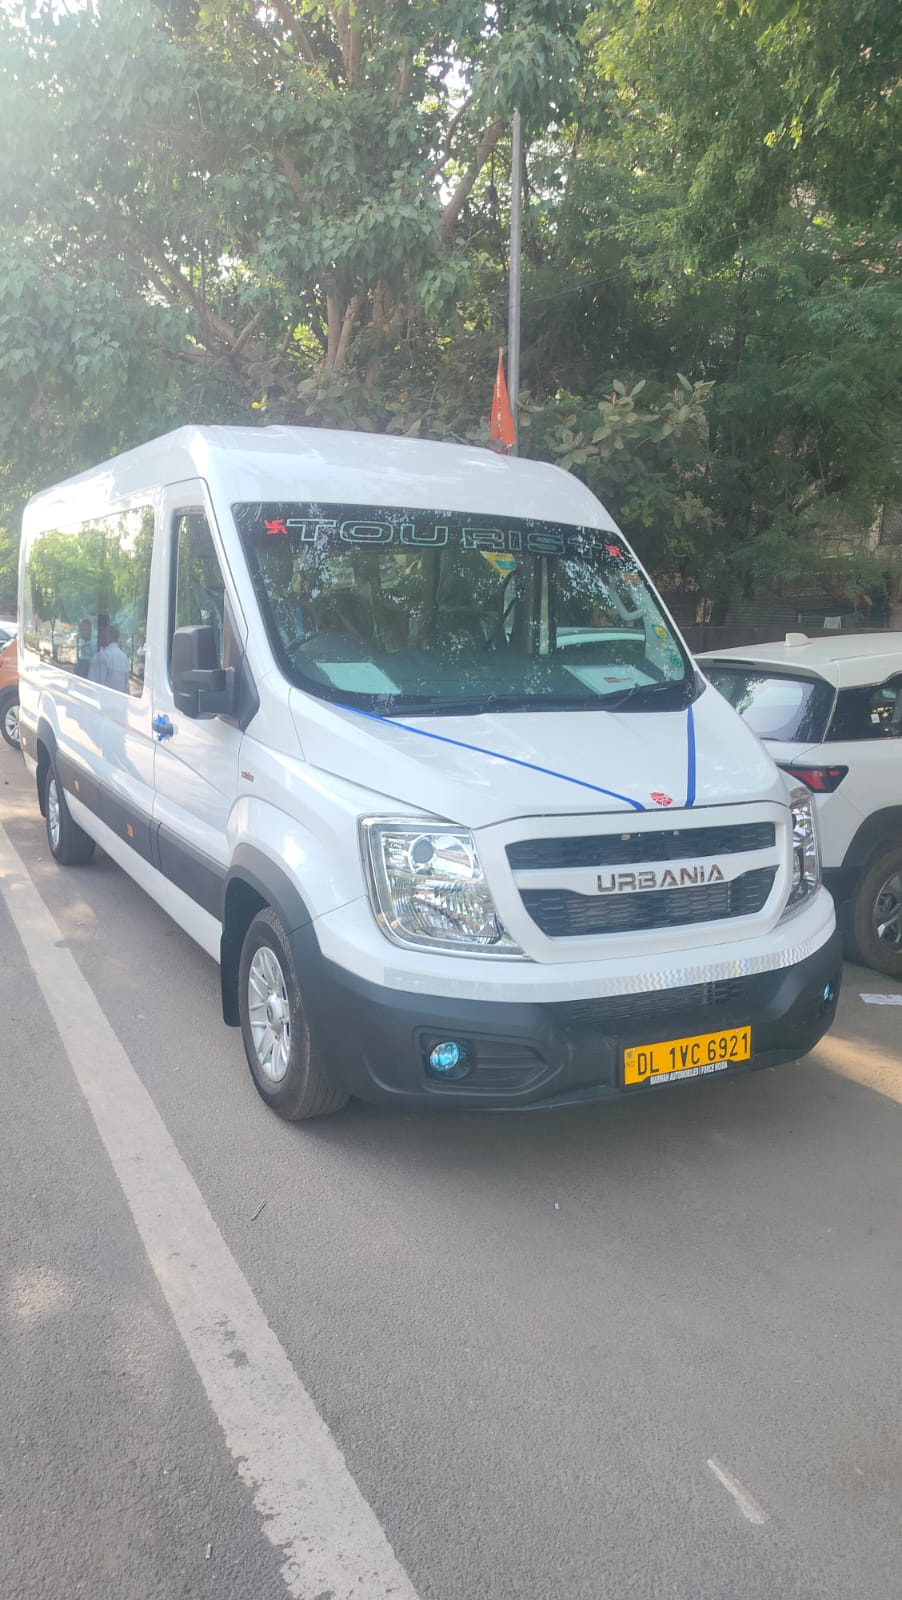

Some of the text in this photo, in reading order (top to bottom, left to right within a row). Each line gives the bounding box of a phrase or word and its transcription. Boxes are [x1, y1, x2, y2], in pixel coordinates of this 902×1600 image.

[637, 1033, 748, 1076] DL 1VC 6921
